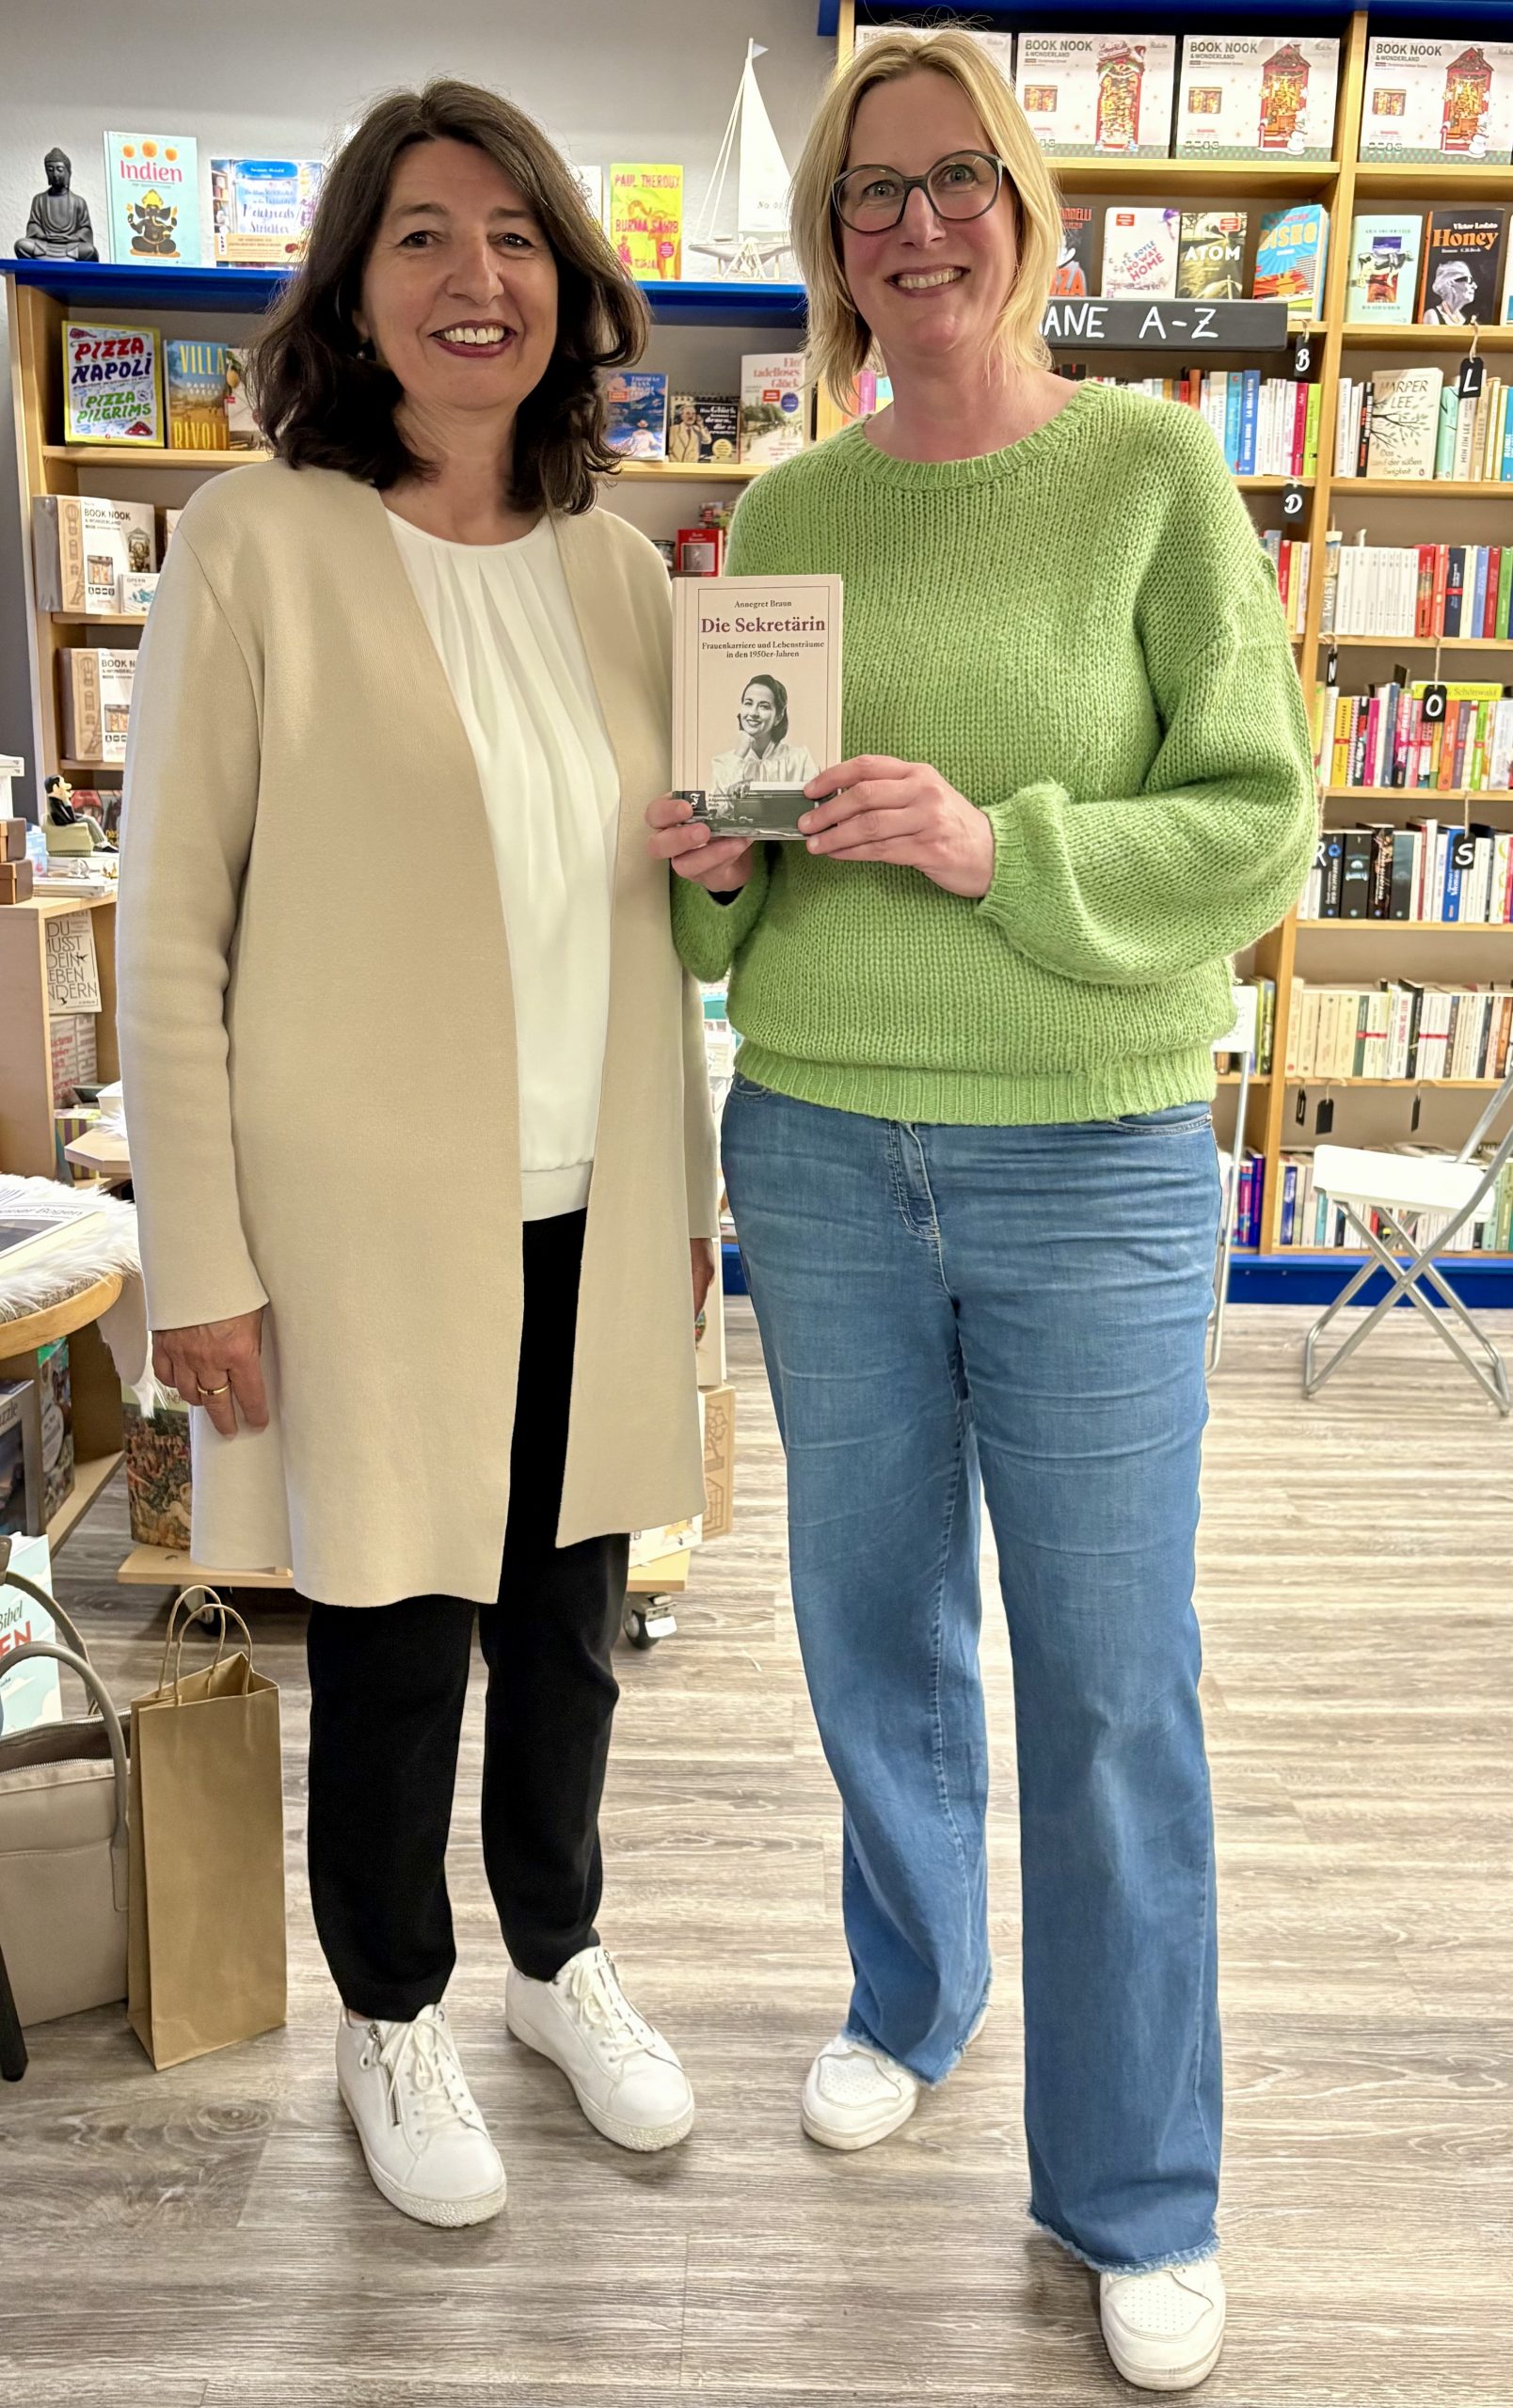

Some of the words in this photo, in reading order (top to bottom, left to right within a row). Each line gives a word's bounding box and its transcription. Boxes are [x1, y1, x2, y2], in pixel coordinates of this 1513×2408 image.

[1025, 40, 1058, 51] BOOK
[1060, 40, 1093, 52] NOOK
[1190, 41, 1223, 53] BOOK
[1226, 42, 1258, 54] NOOK
[1376, 43, 1408, 55] BOOK
[1409, 45, 1442, 56] NOOK
[119, 160, 183, 182] Indien
[614, 174, 638, 188] PAUL
[641, 174, 679, 188] THEROUX
[615, 218, 648, 234] BURMA
[651, 219, 679, 234] SAHIB
[1259, 222, 1317, 252] DISKO
[1432, 229, 1499, 250] Honey
[1125, 260, 1140, 273] NO
[1139, 246, 1158, 263] WAY
[1185, 246, 1241, 261] ATOM
[1129, 252, 1165, 282] HOME
[1040, 303, 1108, 338] ANE
[74, 337, 144, 362] PIZZA
[179, 345, 225, 375] VILLA
[1295, 348, 1310, 372] B
[187, 382, 221, 390] DANIEL
[1379, 380, 1428, 392] HARPER
[1463, 368, 1479, 392] L
[85, 391, 135, 408] PIZZA
[1391, 396, 1412, 408] LEE
[76, 404, 151, 424] PILGRIMS
[1284, 495, 1303, 514] D
[84, 509, 106, 518] BOOK
[108, 511, 132, 520] NOOK
[734, 599, 769, 610] Annegret
[770, 599, 792, 608] Braun
[1323, 580, 1332, 618] TWIST
[701, 617, 730, 633] Die
[735, 615, 826, 633] Sekretärin
[702, 642, 756, 651] Frauenkarriere
[772, 641, 825, 649] Lebensträume
[750, 650, 800, 658] 1950er-Jahren
[102, 659, 127, 668] BOOK
[1328, 658, 1337, 683] N
[1314, 842, 1327, 867] R
[1455, 844, 1473, 865] S
[47, 921, 70, 937] DU
[49, 967, 85, 985] EBEN
[48, 982, 98, 1000] NDERN
